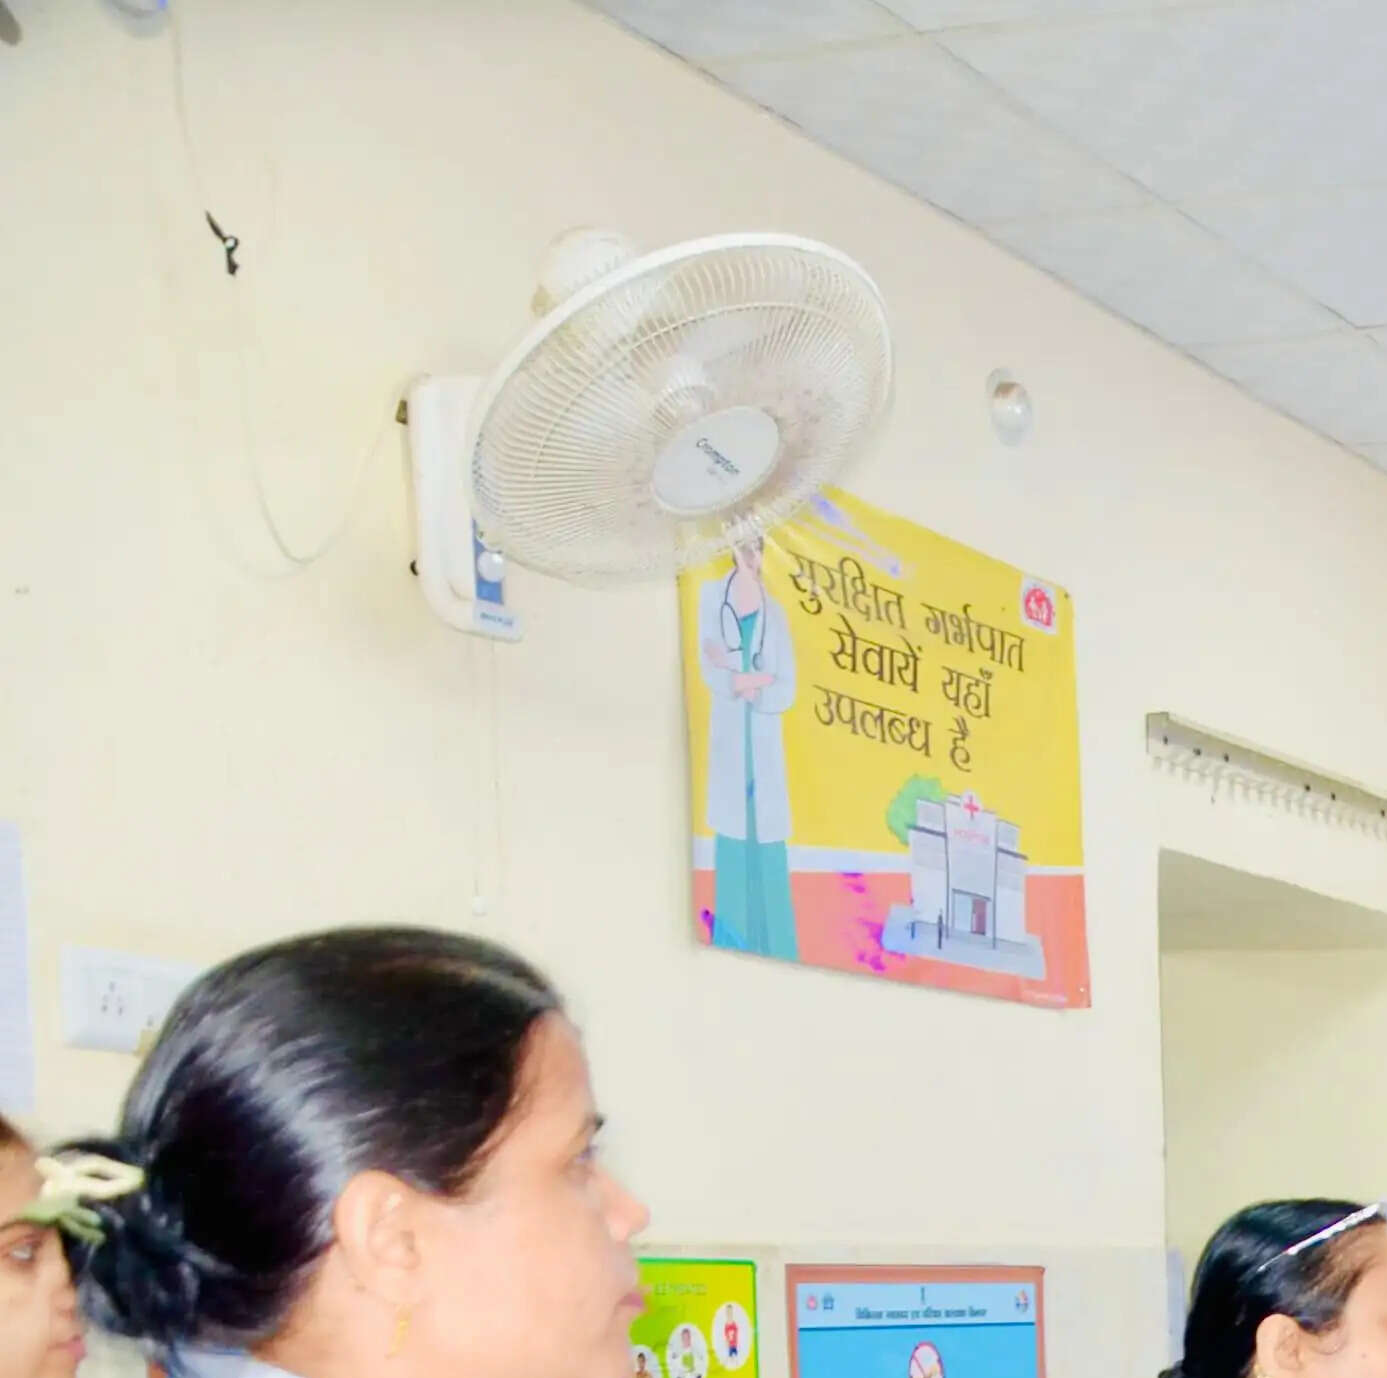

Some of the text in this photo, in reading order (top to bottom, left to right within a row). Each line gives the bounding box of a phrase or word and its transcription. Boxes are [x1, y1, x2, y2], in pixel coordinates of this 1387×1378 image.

[696, 438, 740, 475] Crompton
[788, 550, 1024, 673] सुरक्षित गर्भपात
[829, 613, 993, 719] सेवायें यहाँ
[812, 684, 972, 772] उपलब्ध है
